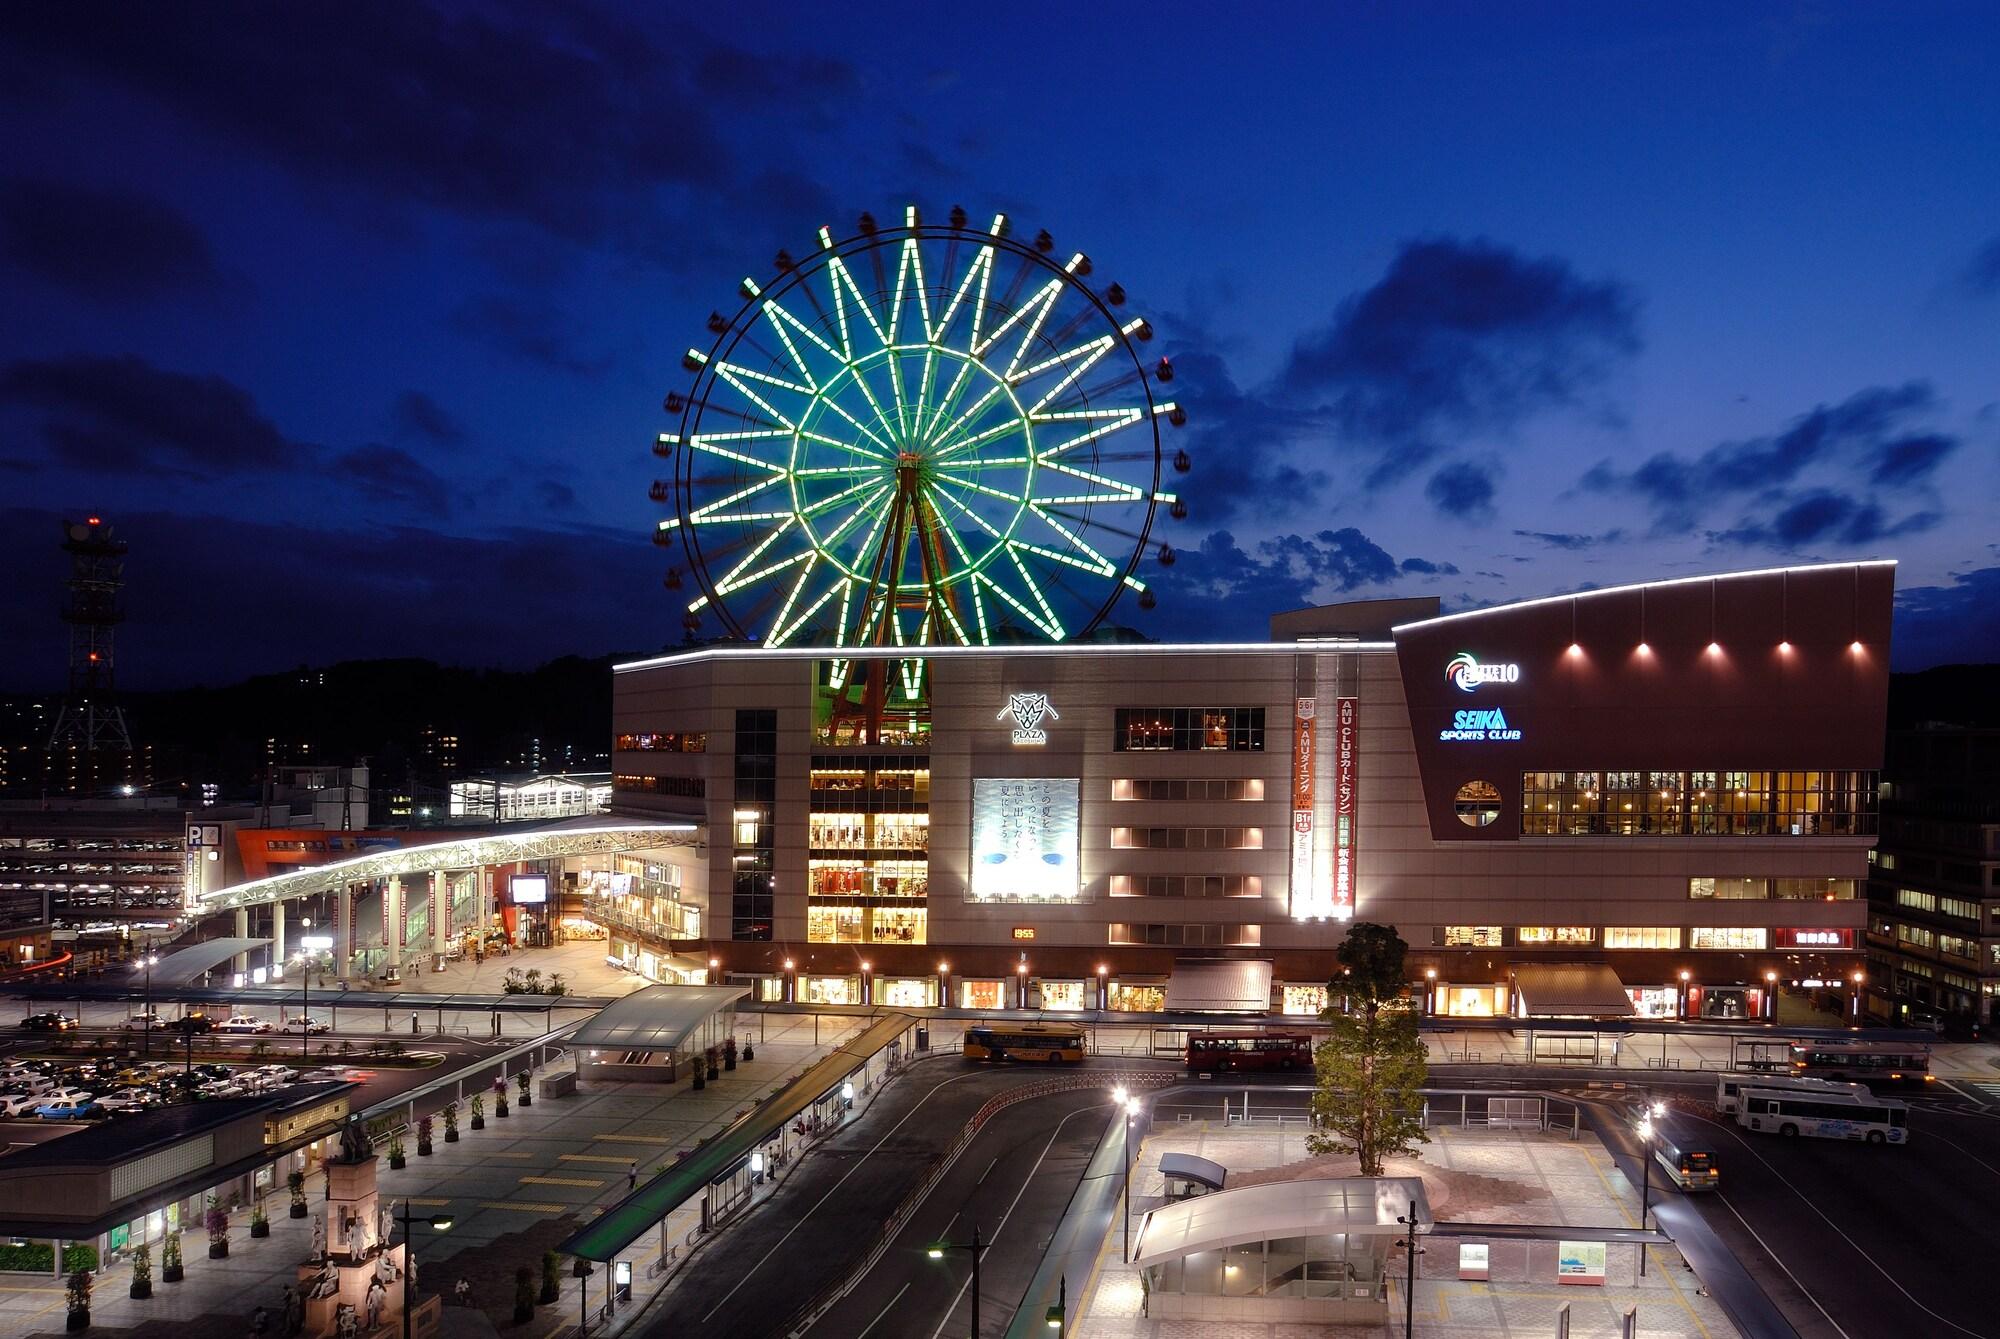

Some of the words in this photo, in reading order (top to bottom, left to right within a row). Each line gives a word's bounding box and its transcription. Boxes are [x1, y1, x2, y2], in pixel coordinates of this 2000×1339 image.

[1342, 701, 1352, 724] AMU
[1454, 707, 1507, 730] SEIKA
[1013, 730, 1045, 738] PLAZA
[1440, 730, 1485, 740] SPORTS
[1488, 730, 1521, 740] CLUB
